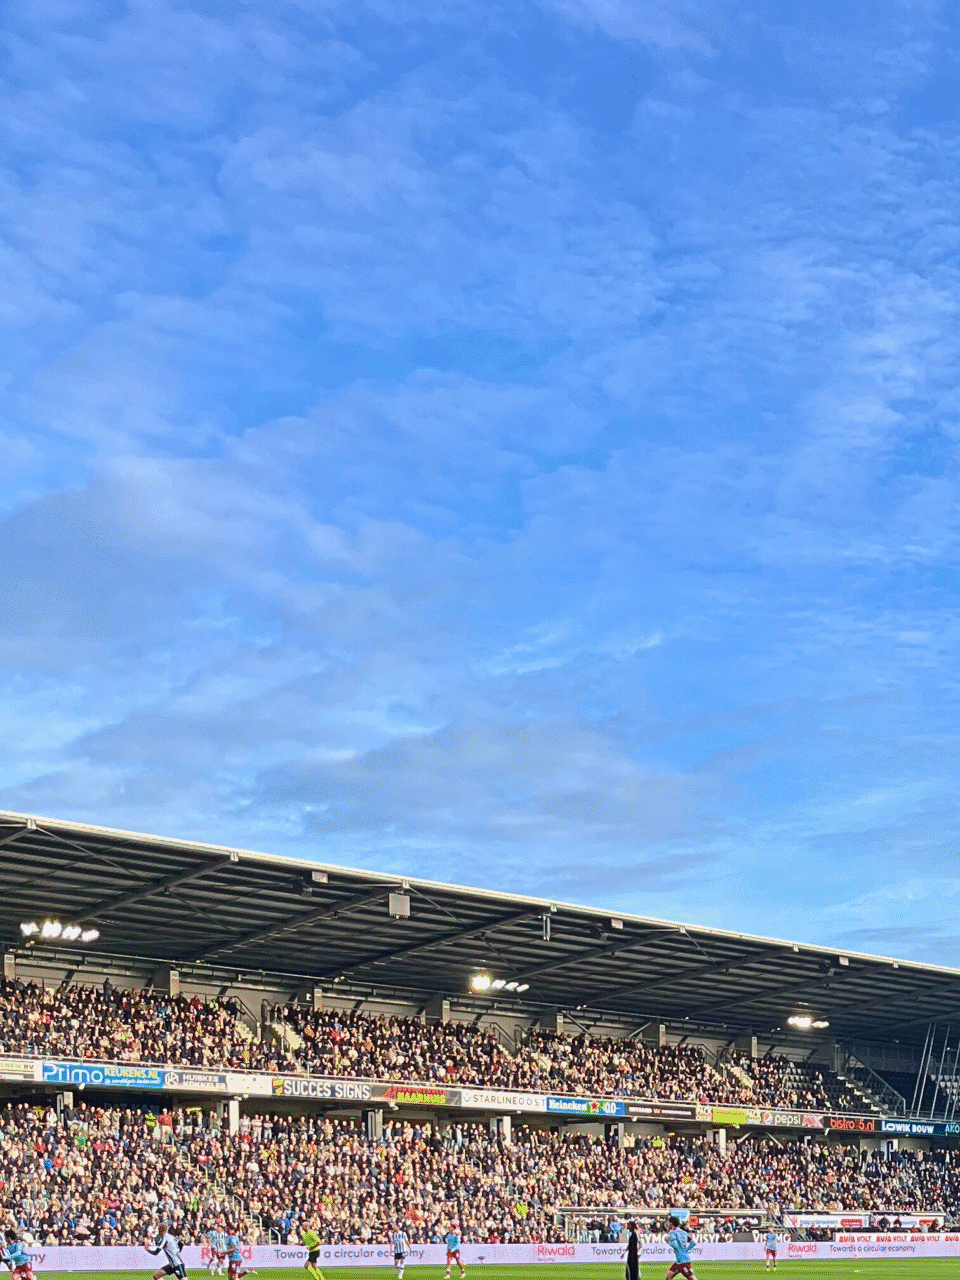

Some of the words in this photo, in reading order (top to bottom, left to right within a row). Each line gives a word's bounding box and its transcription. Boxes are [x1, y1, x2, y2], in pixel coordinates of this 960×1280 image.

[44, 1064, 103, 1083] Primo
[284, 1079, 331, 1097] SUCCES
[335, 1083, 370, 1099] SIGNS
[549, 1099, 588, 1112] Heineken
[774, 1114, 801, 1127] pepsi
[912, 1125, 934, 1134] BOUW
[753, 1233, 790, 1242] VISMO
[323, 1250, 331, 1258] a
[334, 1247, 374, 1258] circular
[537, 1244, 576, 1257] Riwald
[787, 1243, 817, 1253] Riwald
[829, 1244, 855, 1252] Towards
[863, 1243, 886, 1252] circular
[887, 1245, 915, 1253] economy
